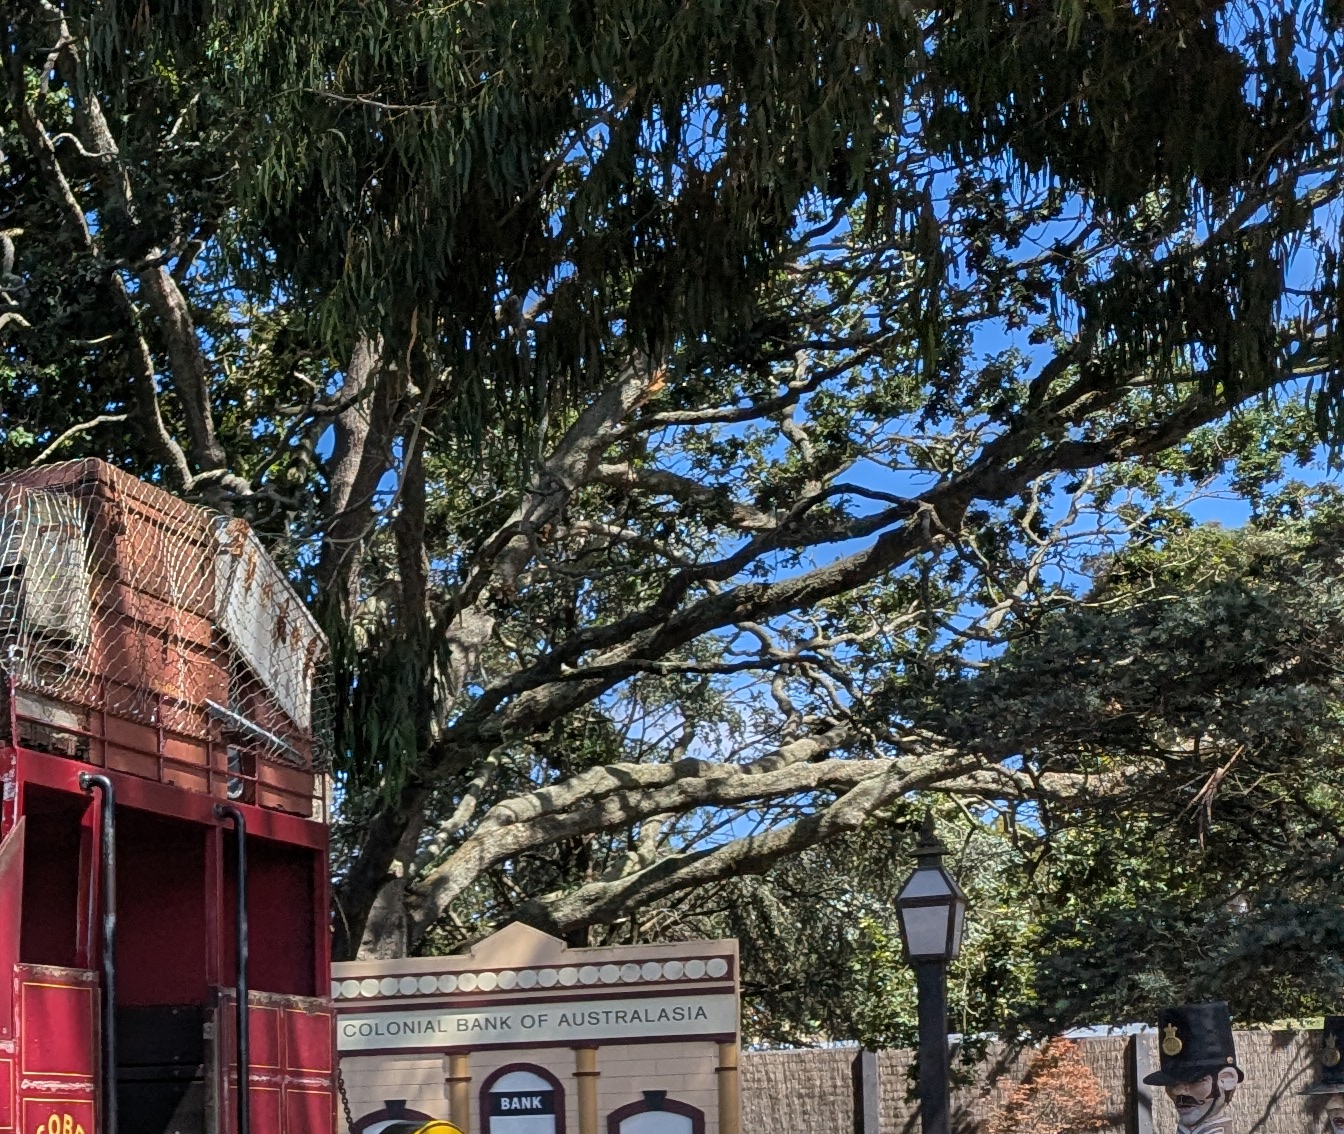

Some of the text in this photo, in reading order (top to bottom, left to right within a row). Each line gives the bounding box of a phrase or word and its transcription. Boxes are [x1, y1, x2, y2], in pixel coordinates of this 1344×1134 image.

[343, 1006, 708, 1038] COLONIAL BANK OF AUSTRALASIA
[500, 1096, 543, 1110] BANK
